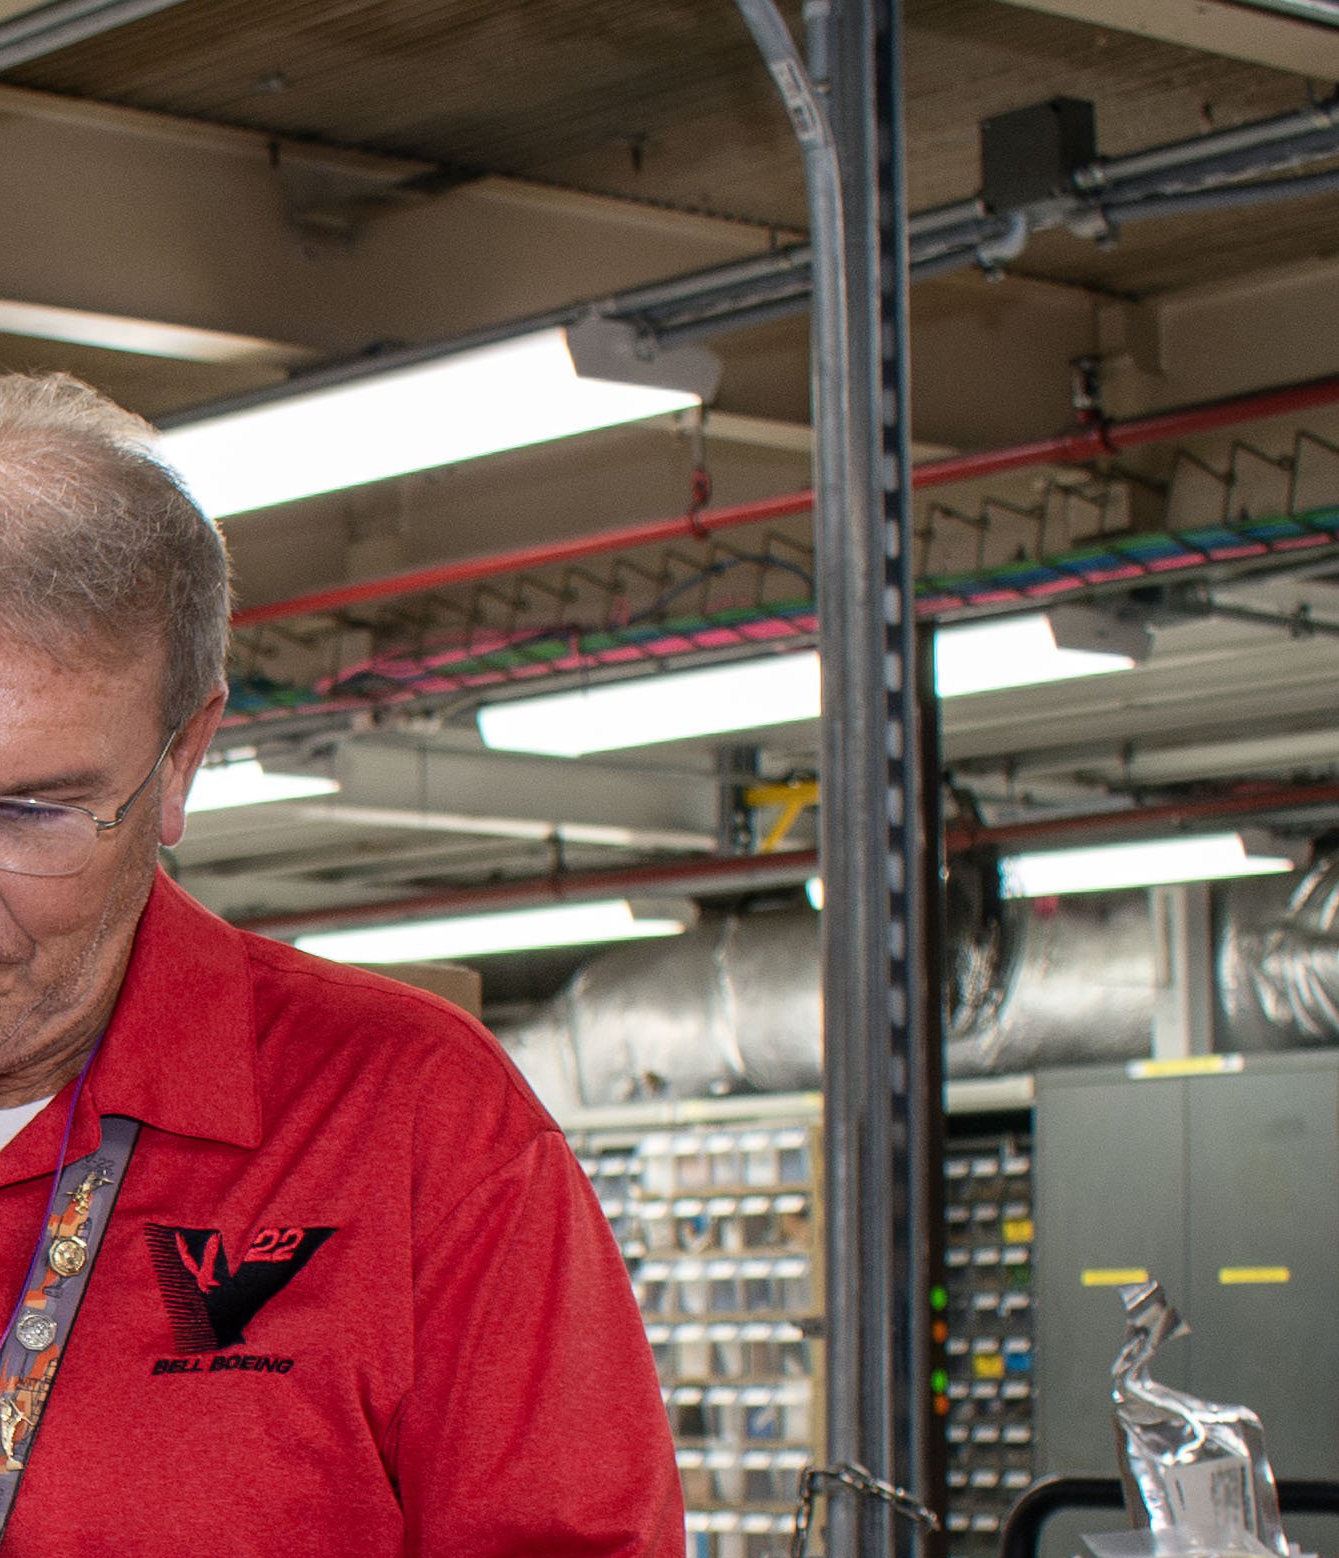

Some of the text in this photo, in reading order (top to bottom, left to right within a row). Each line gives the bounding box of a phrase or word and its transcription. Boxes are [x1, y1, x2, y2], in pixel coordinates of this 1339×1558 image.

[244, 1227, 305, 1262] 22
[152, 1355, 295, 1376] BELL BOEING
